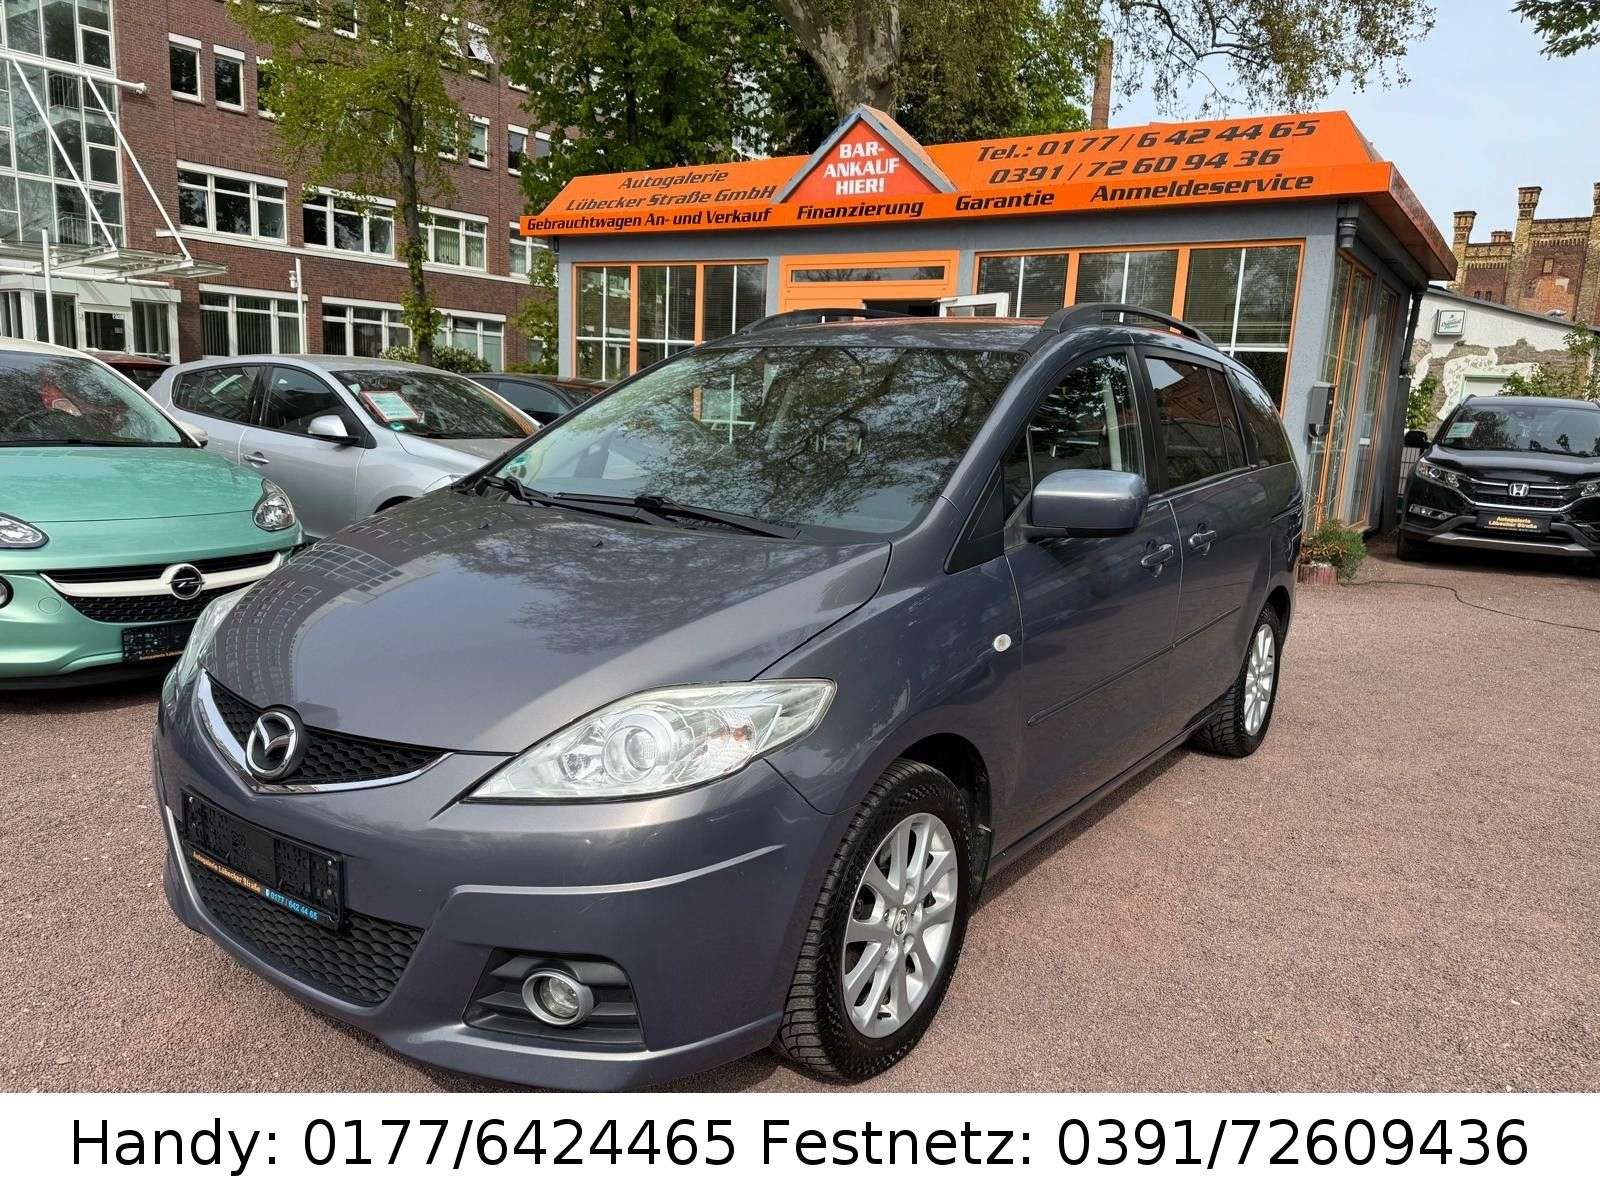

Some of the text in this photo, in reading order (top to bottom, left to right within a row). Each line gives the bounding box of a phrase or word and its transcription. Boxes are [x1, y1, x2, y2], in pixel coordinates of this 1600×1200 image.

[839, 140, 885, 158] BAR-
[977, 144, 1032, 162] Tel.:
[1037, 134, 1119, 156] 0177
[823, 157, 900, 178] ANKAUF
[987, 163, 1064, 185] 0391
[1087, 159, 1128, 177] 72
[1131, 155, 1176, 175] 60
[1184, 151, 1230, 170] 94
[1233, 148, 1284, 169] 36
[618, 170, 729, 190] Autogalerie
[835, 177, 885, 196] HIER!
[1090, 172, 1314, 203] Anmeldeservice
[566, 184, 777, 211] Lübecker Straße GmbH
[955, 189, 1055, 211] Garantie
[528, 207, 773, 231] Gebrauchtwagen An- und Verkauf
[796, 200, 925, 220] Finanzierung
